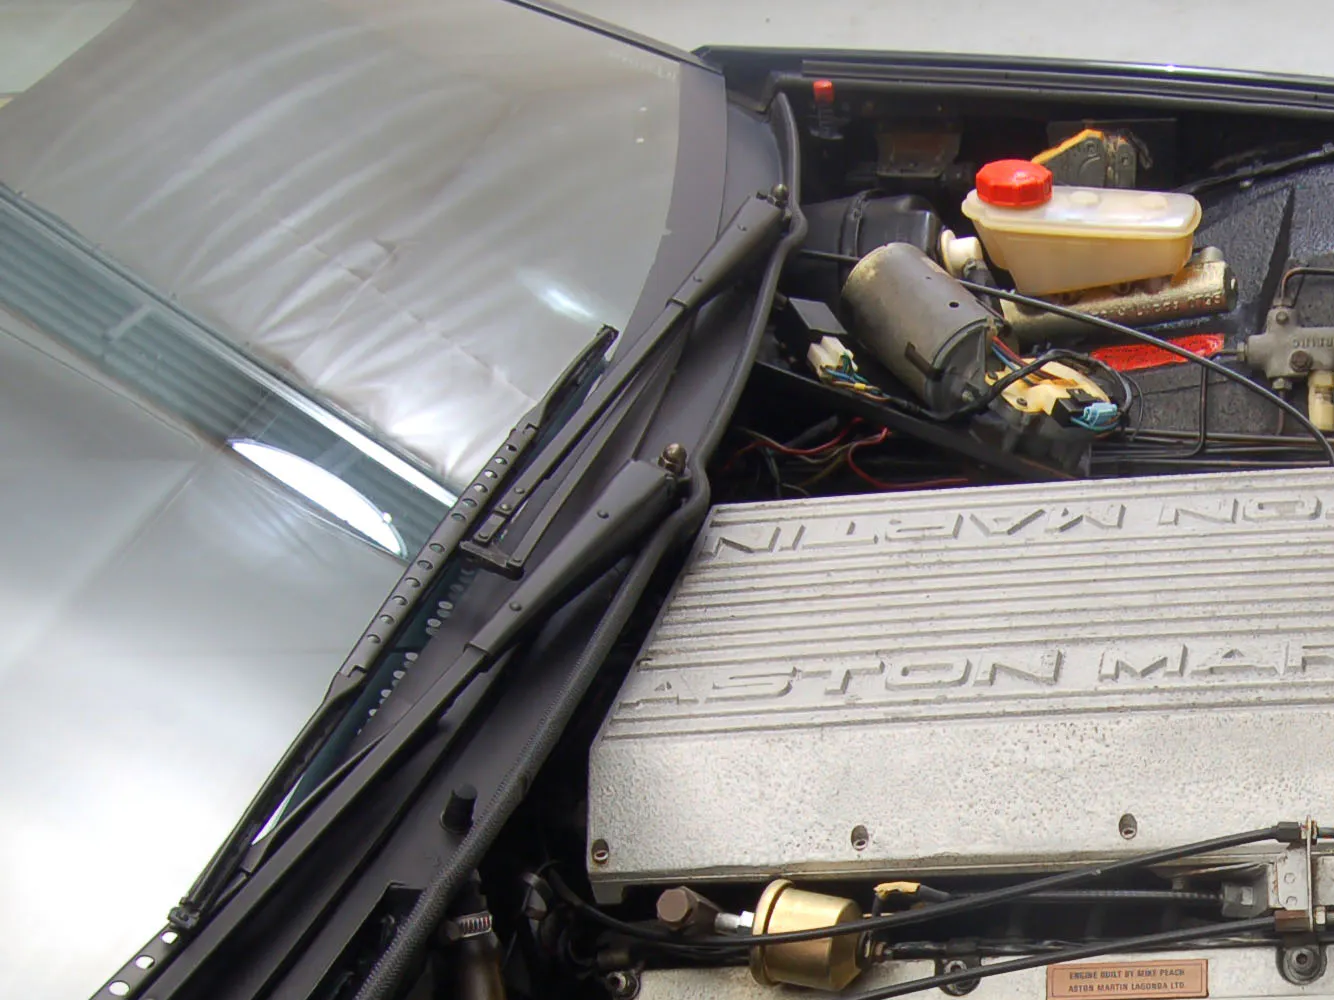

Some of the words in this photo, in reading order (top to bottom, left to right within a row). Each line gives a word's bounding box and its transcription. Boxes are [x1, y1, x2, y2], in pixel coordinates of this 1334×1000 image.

[618, 648, 1065, 708] ASTON
[1069, 971, 1098, 980] ENGINE
[1100, 970, 1122, 979] BUILT
[1124, 970, 1134, 978] BY
[1137, 969, 1157, 978] MIKE
[1159, 968, 1185, 977] PEACH
[1068, 984, 1094, 993] ASTON
[1097, 983, 1128, 991] MARTIN
[1131, 982, 1168, 991] LAGONDA
